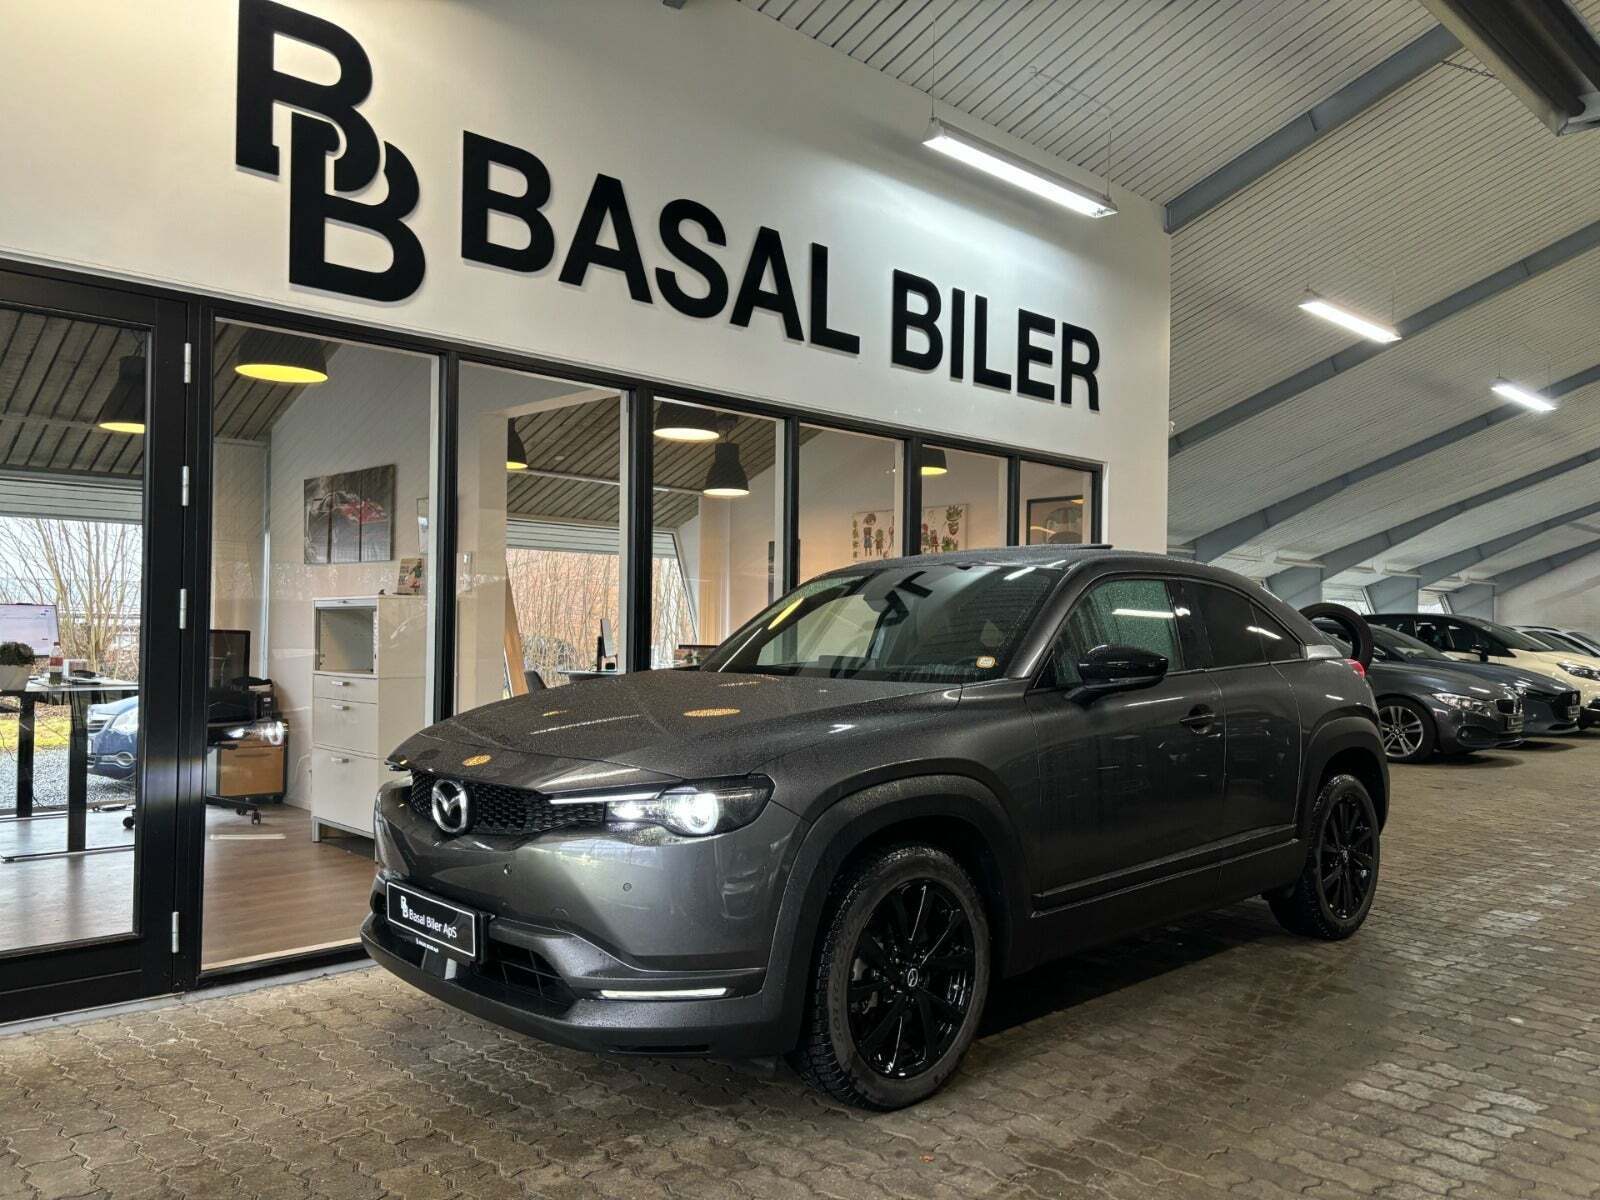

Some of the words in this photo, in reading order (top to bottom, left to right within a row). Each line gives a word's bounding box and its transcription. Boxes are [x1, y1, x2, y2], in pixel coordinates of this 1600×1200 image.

[462, 131, 860, 355] BASAL
[892, 270, 1100, 411] BILER
[409, 908, 425, 926] Basal
[426, 916, 442, 932] Biler
[443, 923, 457, 938] ApS
